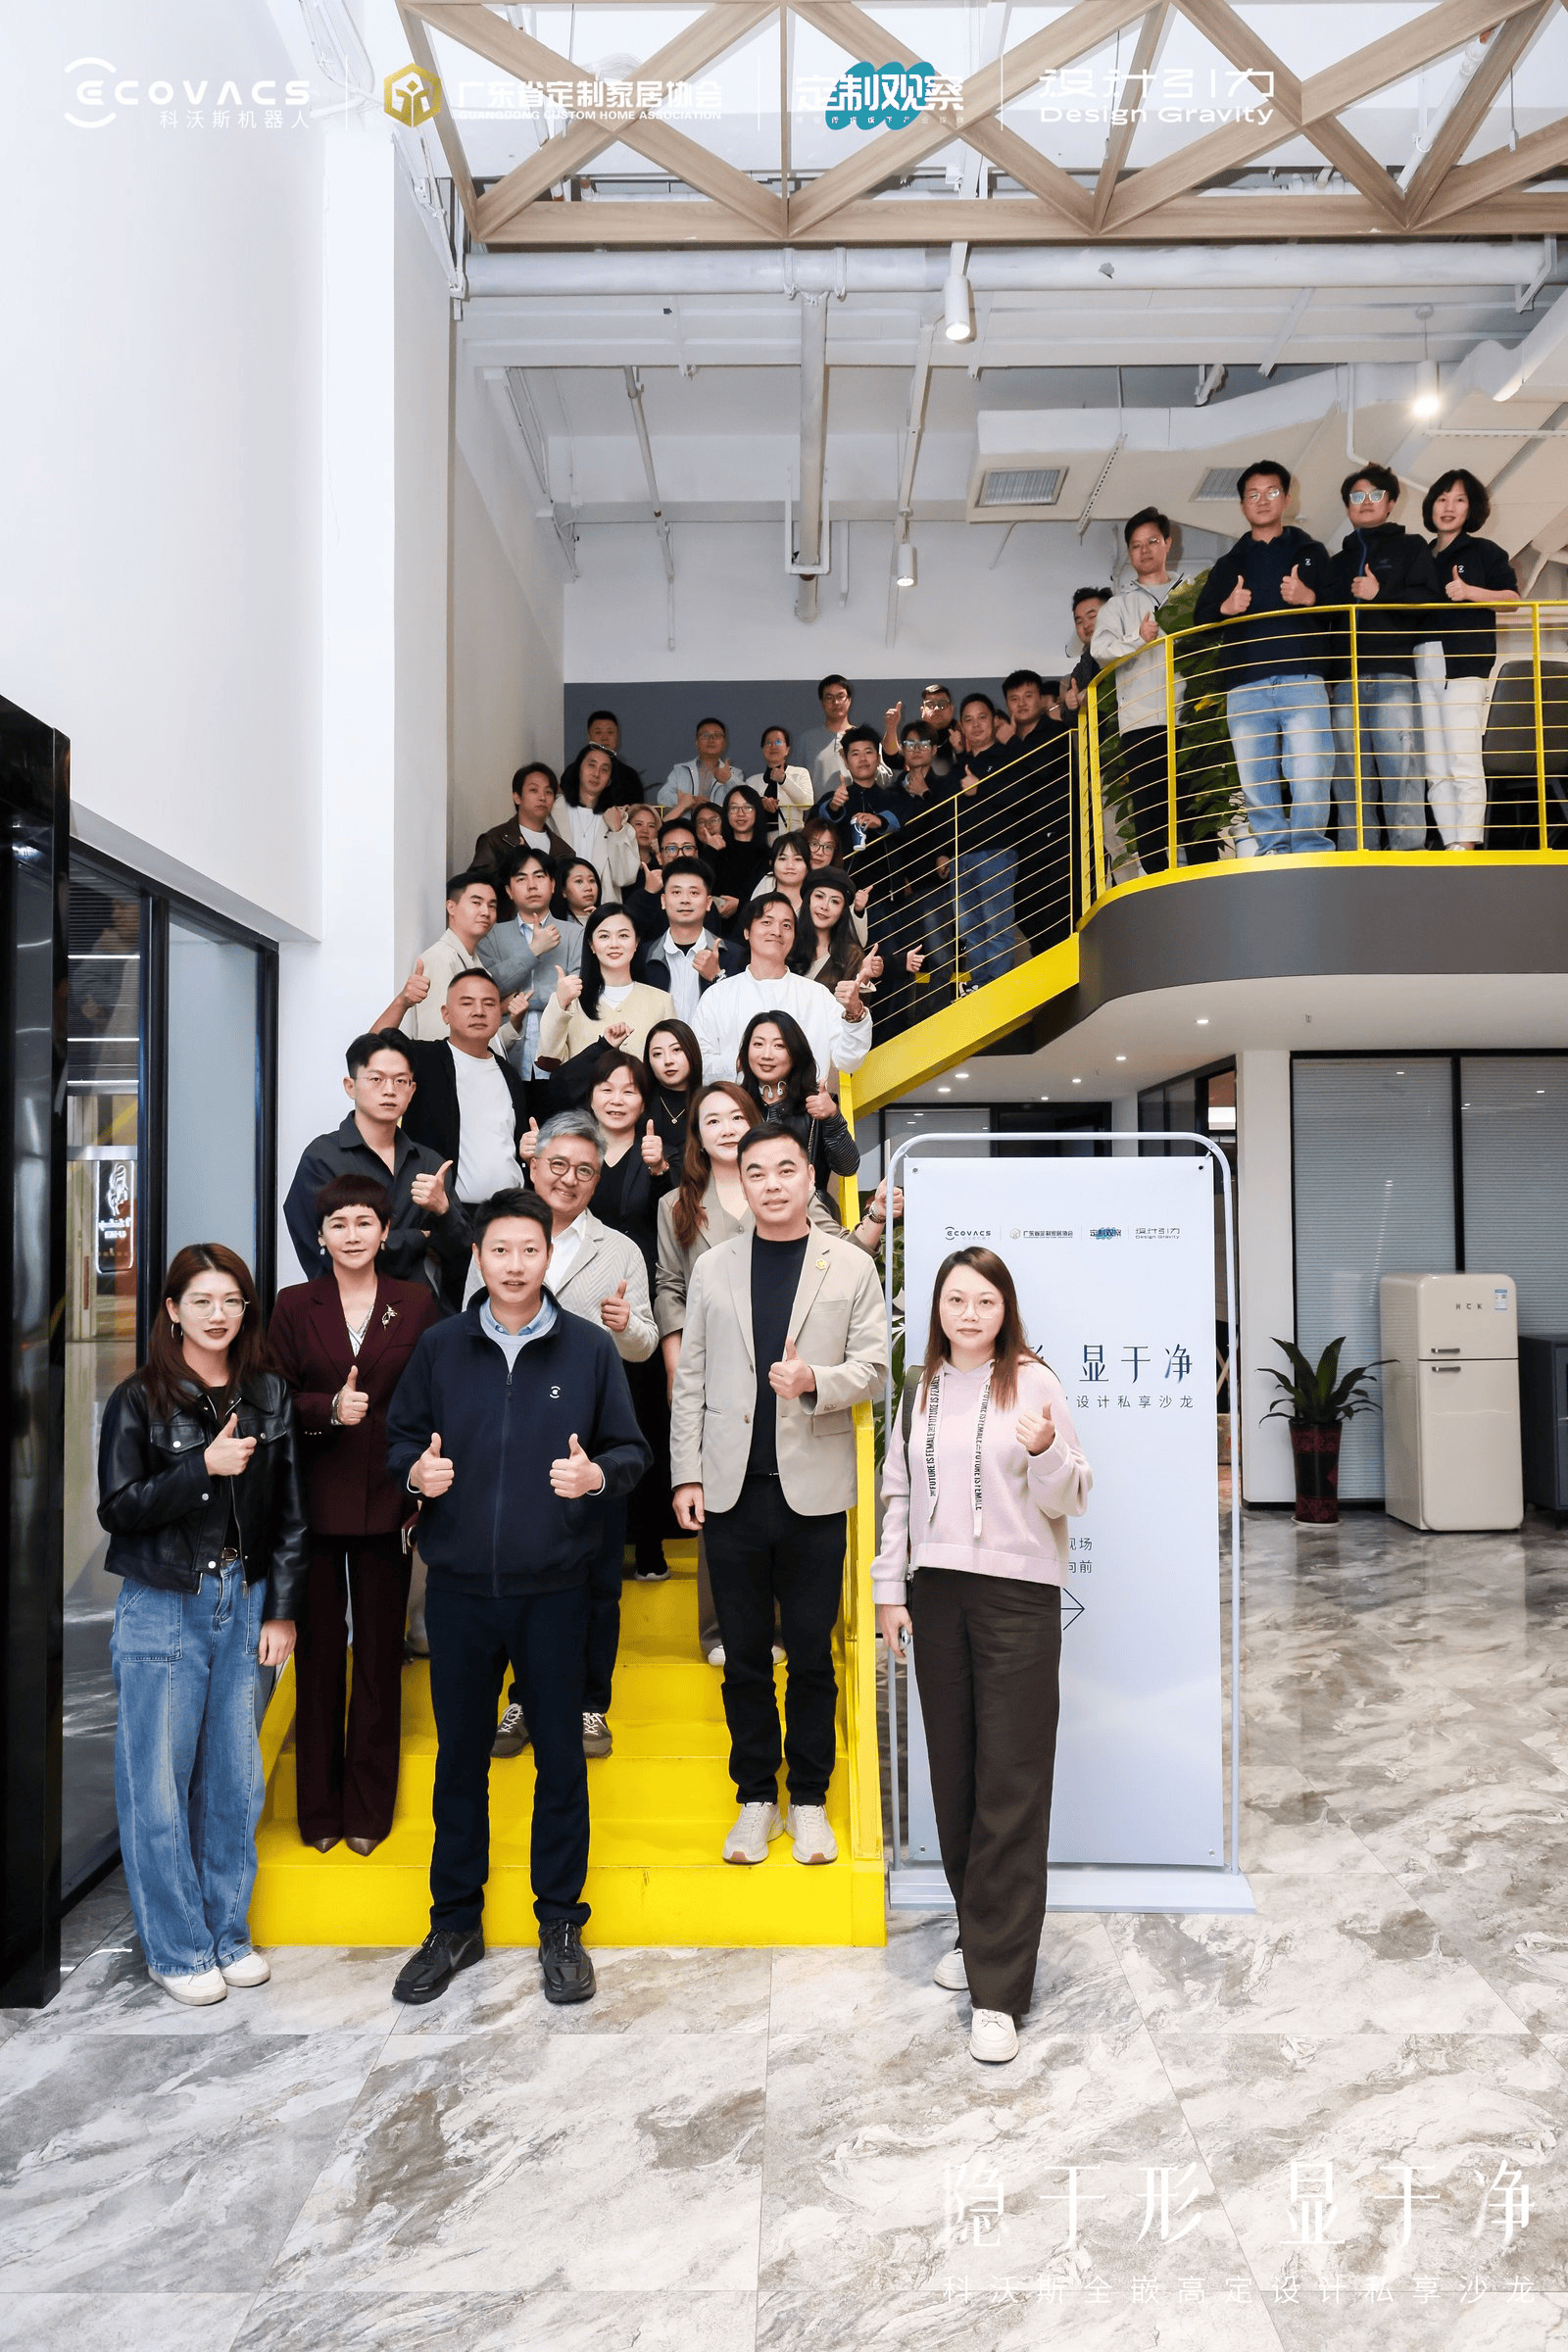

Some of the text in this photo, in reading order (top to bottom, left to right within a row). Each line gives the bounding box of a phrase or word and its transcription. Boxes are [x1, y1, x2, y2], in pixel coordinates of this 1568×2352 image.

[1076, 1395, 1194, 1408] 设计私享沙龙
[925, 1433, 936, 1457] FEMALE
[927, 1464, 937, 1490] FUTURE
